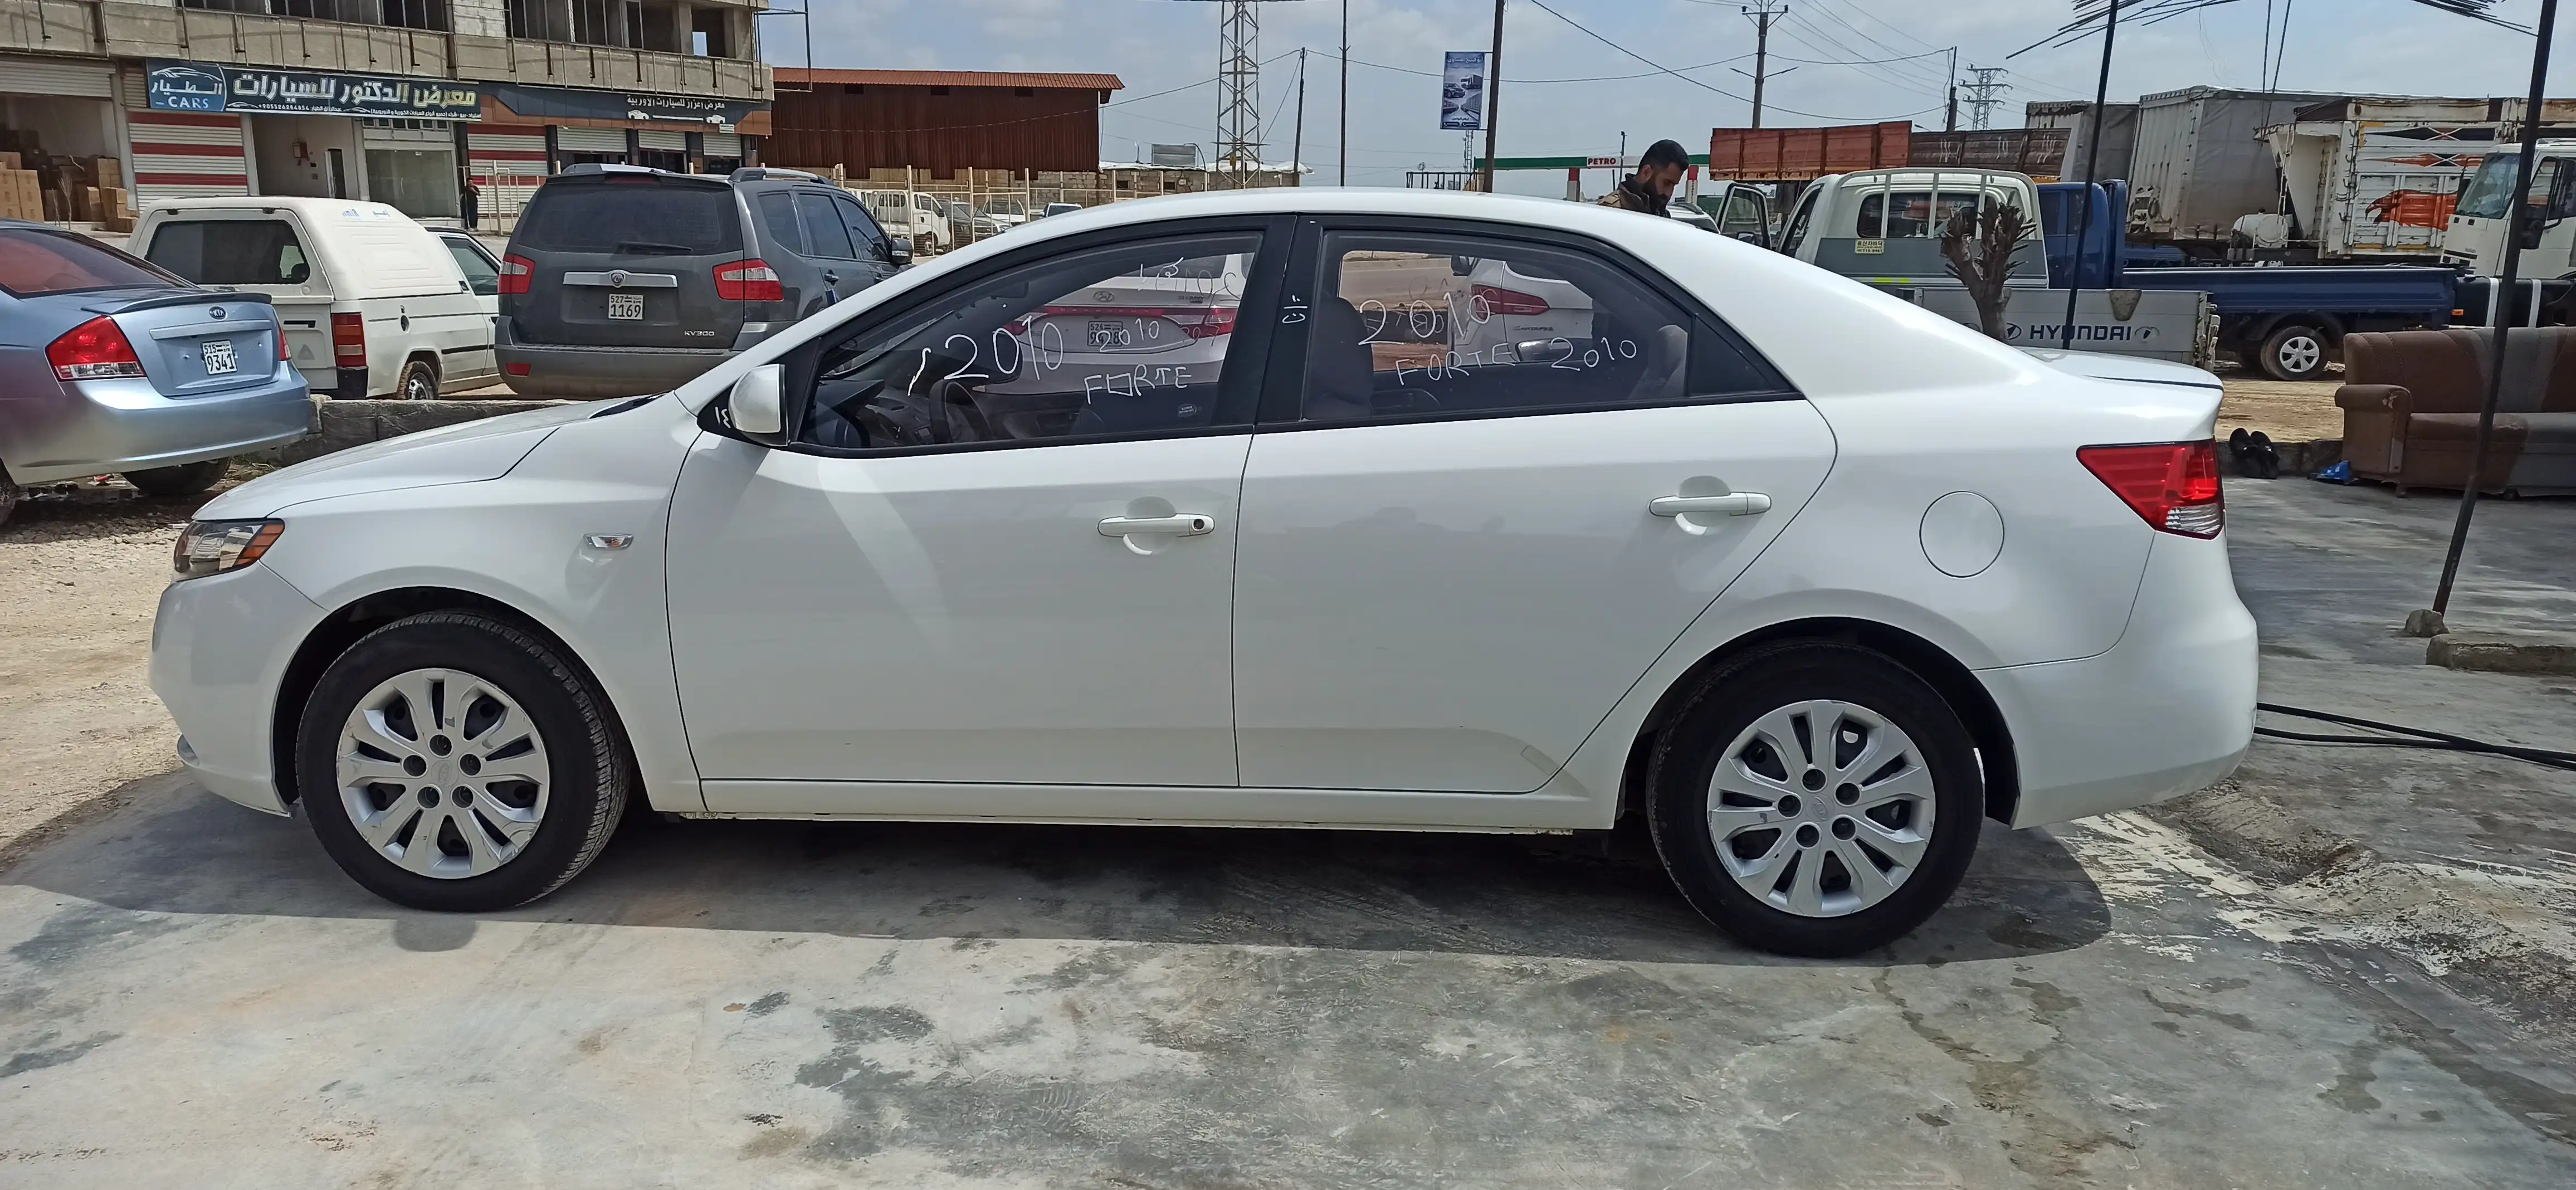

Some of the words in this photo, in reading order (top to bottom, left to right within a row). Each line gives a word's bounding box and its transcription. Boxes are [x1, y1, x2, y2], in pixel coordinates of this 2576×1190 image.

[151, 79, 222, 95] الطيار
[233, 74, 336, 104] للسيارات
[339, 81, 409, 105] الدكتور
[413, 85, 475, 109] معرض
[168, 96, 209, 109] CARS
[657, 97, 685, 109] للسيارات
[705, 100, 725, 110] معرض
[610, 304, 641, 318] 1169
[1358, 292, 1491, 345] 2010
[1096, 318, 1160, 352] 2010
[204, 344, 216, 354] 515
[944, 315, 1063, 381] 2010
[206, 353, 235, 372] 9341
[1396, 343, 1516, 386] FORTE
[1551, 337, 1637, 372] 2010
[1084, 364, 1192, 405] FORTE
